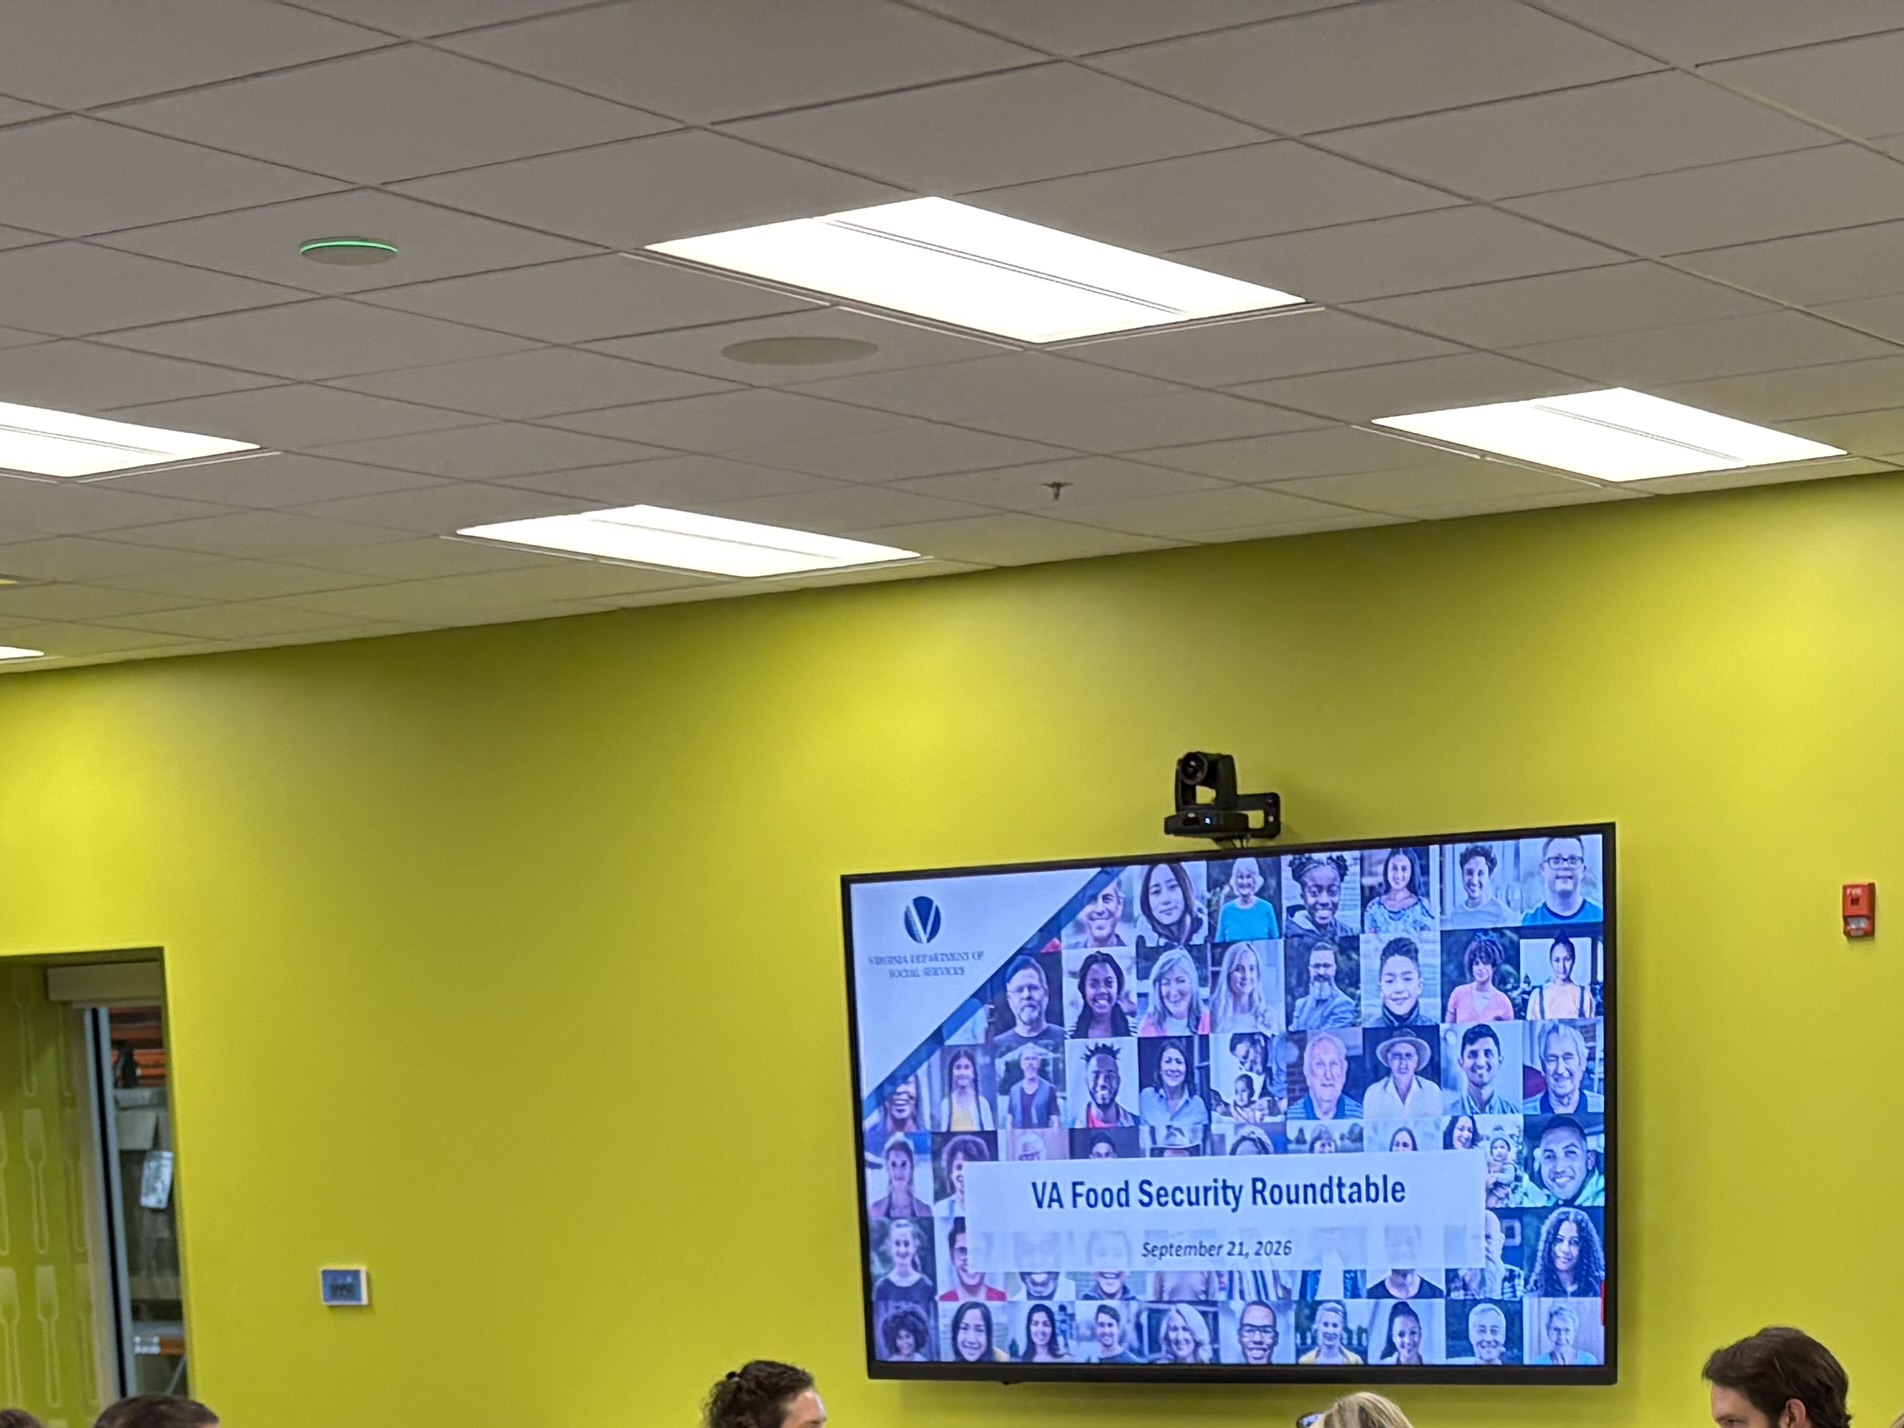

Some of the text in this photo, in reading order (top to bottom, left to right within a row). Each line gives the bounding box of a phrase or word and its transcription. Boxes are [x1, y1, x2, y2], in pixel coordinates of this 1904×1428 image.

[1031, 1173, 1407, 1213] VA Food Security Roundtable
[1141, 1240, 1293, 1260] September 21, 2026
